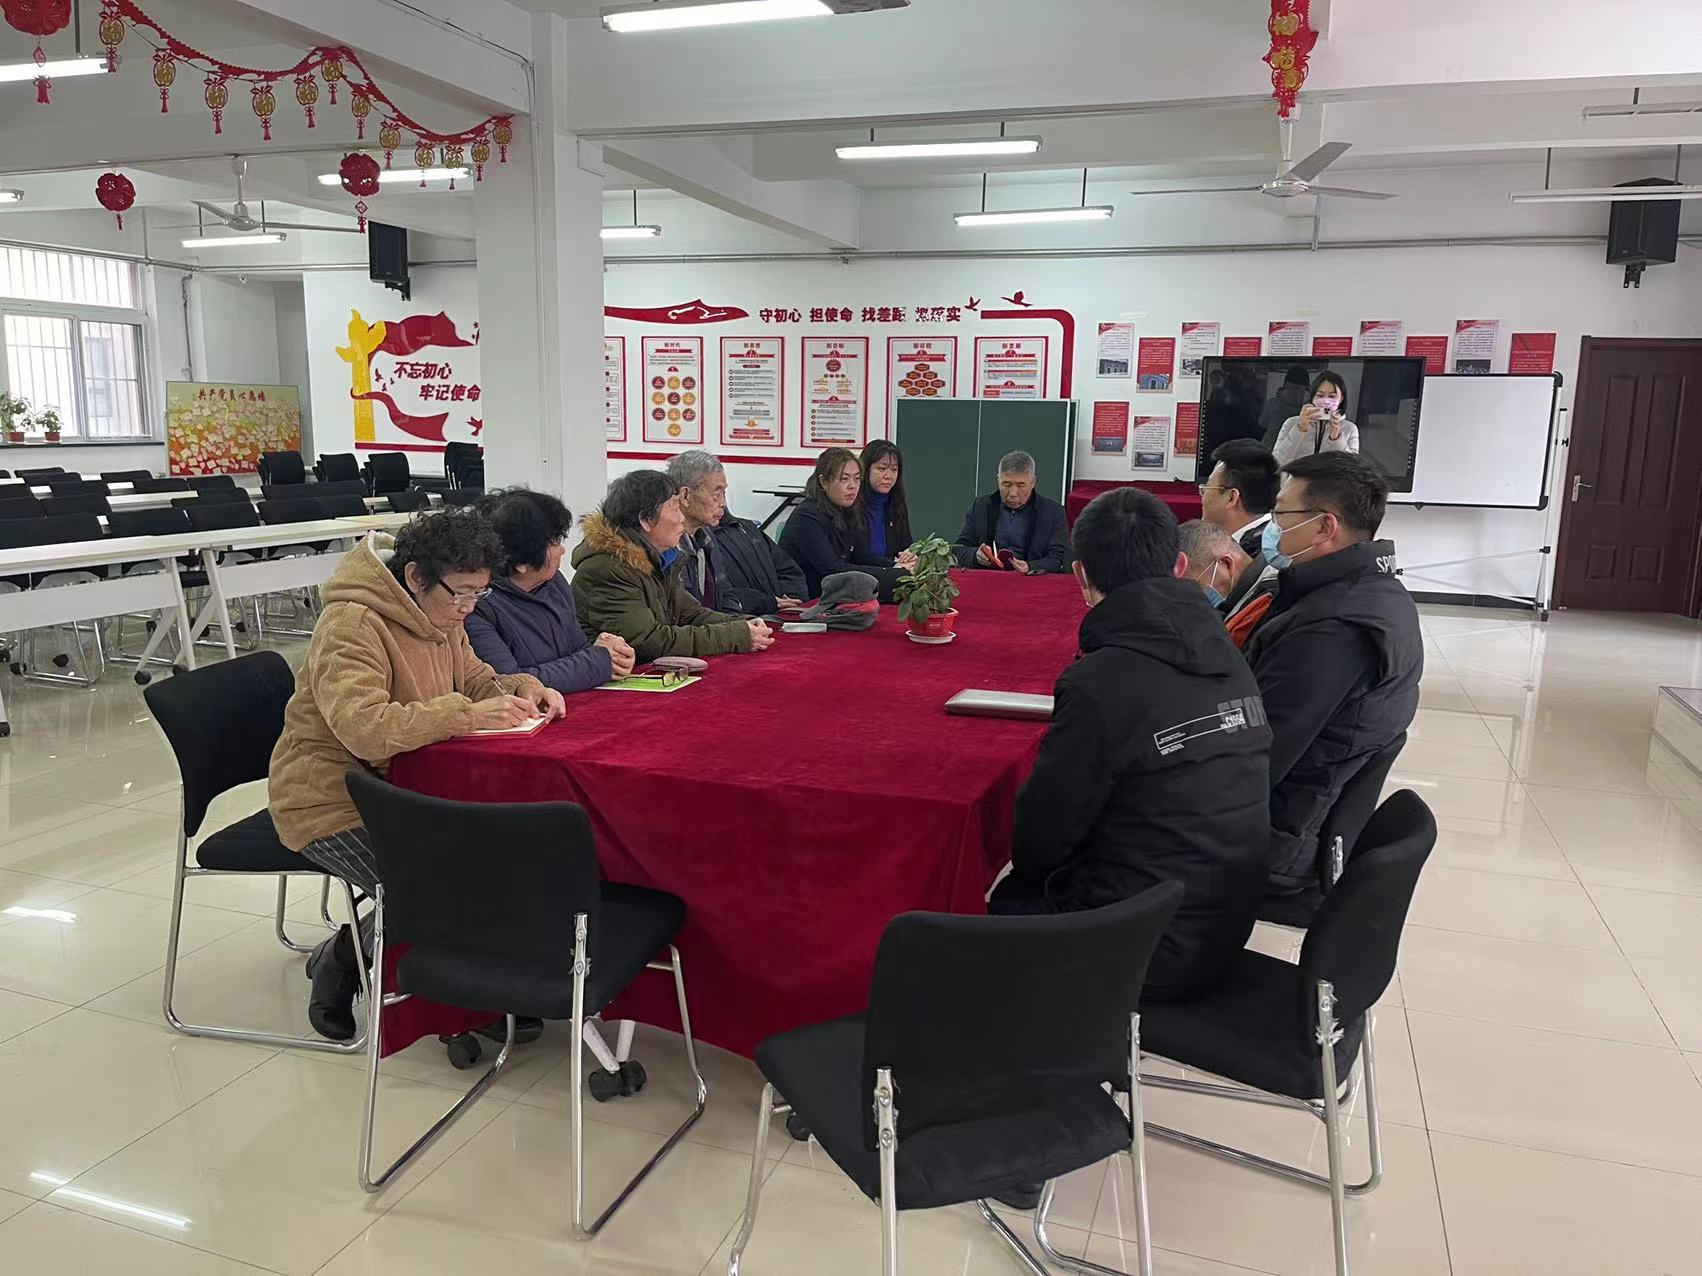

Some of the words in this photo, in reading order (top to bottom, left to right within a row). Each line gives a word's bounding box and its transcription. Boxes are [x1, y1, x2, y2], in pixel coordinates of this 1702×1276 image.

[759, 307, 801, 323] 守初心
[809, 307, 853, 323] 担使命
[394, 361, 452, 379] 不忘初心
[419, 383, 482, 401] 牢记使命
